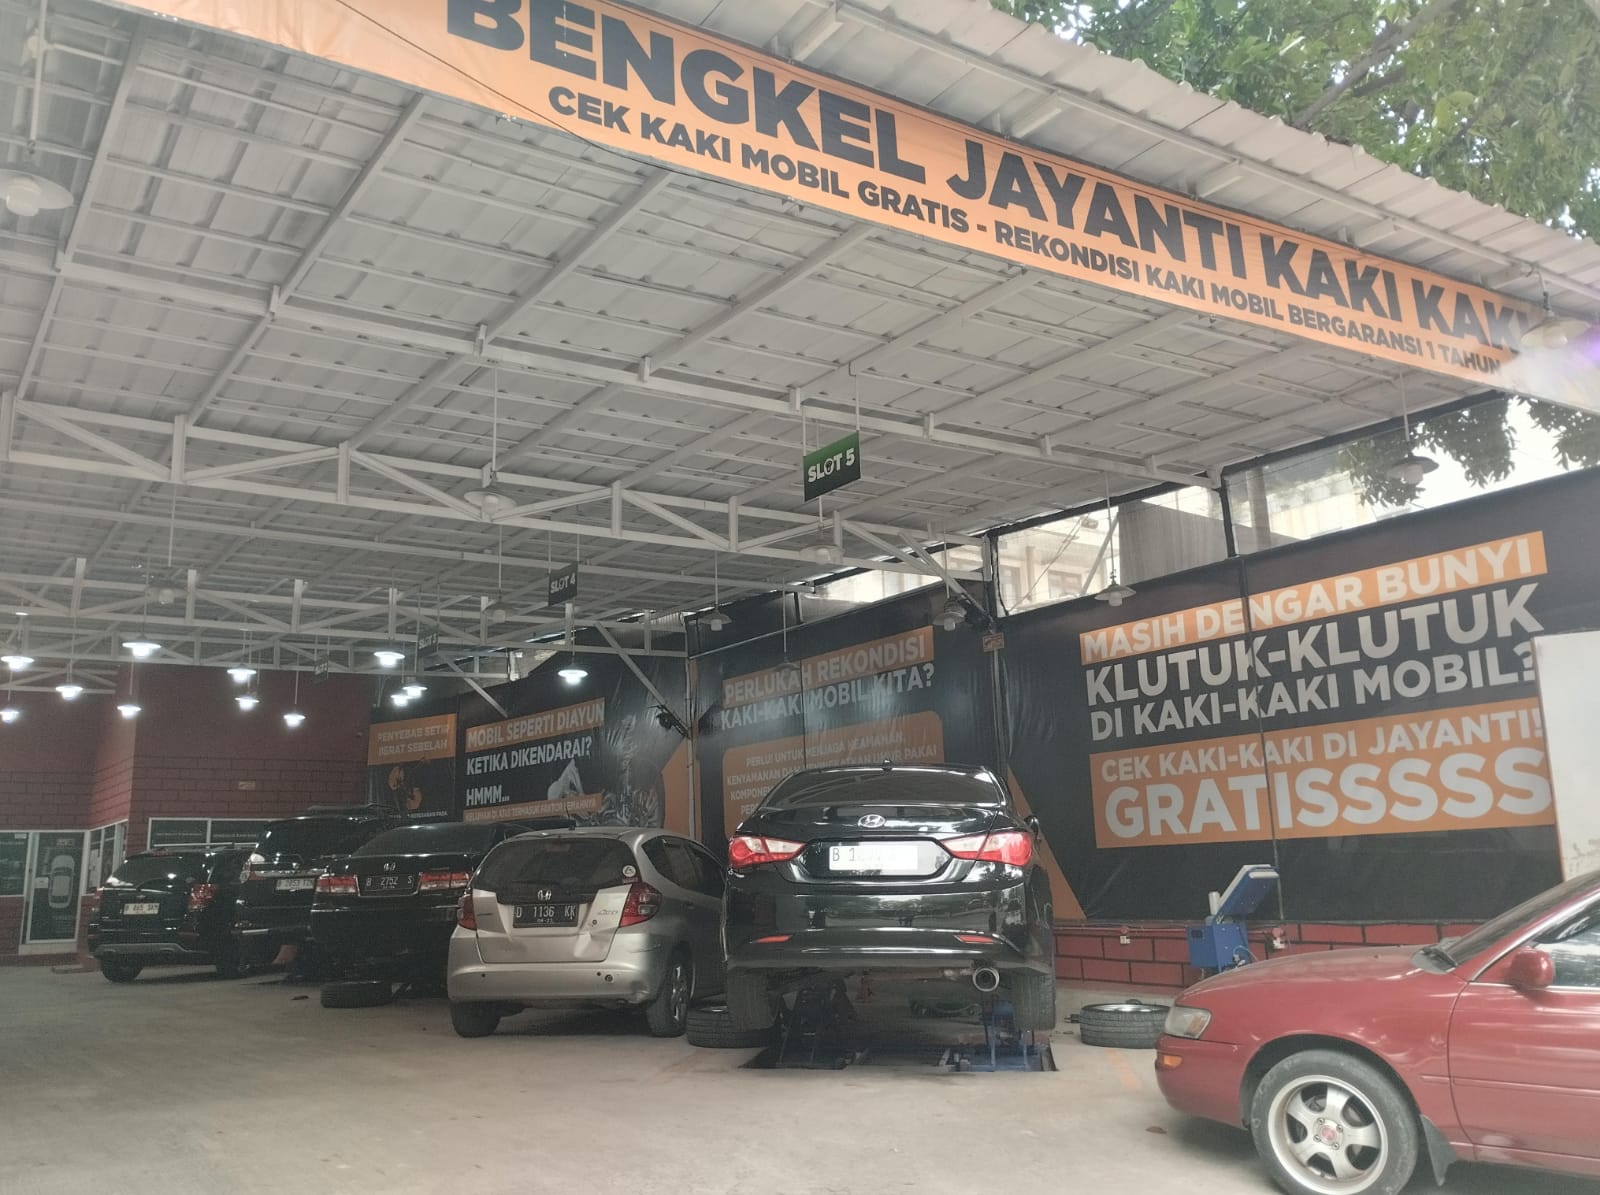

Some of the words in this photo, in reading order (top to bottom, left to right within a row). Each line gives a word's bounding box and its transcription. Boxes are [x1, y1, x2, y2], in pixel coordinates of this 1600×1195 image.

[447, 0, 926, 184] BENGKEL
[946, 139, 1247, 279] JAYANTI
[1259, 232, 1402, 322] KAKI
[548, 86, 630, 134] CEK
[641, 114, 731, 163] KAKI
[741, 143, 849, 199] MOBIL
[858, 180, 969, 233] GRATIS
[977, 223, 987, 232] -
[994, 220, 1139, 282] REKONDISI
[1146, 264, 1205, 300] KAKI
[1211, 282, 1284, 321] MOBIL
[1288, 304, 1423, 356] BERGARANSI
[1426, 340, 1435, 361] 1
[1438, 343, 1500, 375] TAHUN
[808, 453, 843, 482] SLOT
[846, 448, 855, 466] 5
[551, 575, 570, 594] SLOT
[570, 572, 576, 585] 4
[1084, 614, 1185, 662] MASIH
[1196, 575, 1363, 640] DENGAR
[1377, 536, 1531, 600] BUNYI
[725, 663, 812, 702] PERLUKAH
[818, 634, 925, 682] REKONDISI
[1086, 583, 1544, 706] KLUTUK-KLUTUK
[808, 678, 868, 711] MOBIL
[872, 663, 935, 698] KITA?
[1091, 707, 1124, 741] DI
[1133, 679, 1339, 735] KAKI-KAKI
[1354, 641, 1535, 704] MOBIL?
[468, 726, 504, 749] MOBIL
[507, 714, 554, 740] SEPERTI
[557, 703, 605, 731] DIAYUN
[1101, 757, 1152, 782] CEK
[1159, 734, 1313, 777] KAKI-KAKI
[1324, 731, 1356, 761] DI
[1369, 708, 1543, 755] JAYANTI!
[467, 751, 508, 775] KETIKA
[511, 736, 592, 768] DIKENDARAI?
[466, 784, 510, 806] HMMM...
[1105, 747, 1552, 839] GRATISSSSS
[832, 848, 840, 862] B
[516, 907, 523, 918] D
[533, 906, 554, 918] 1136
